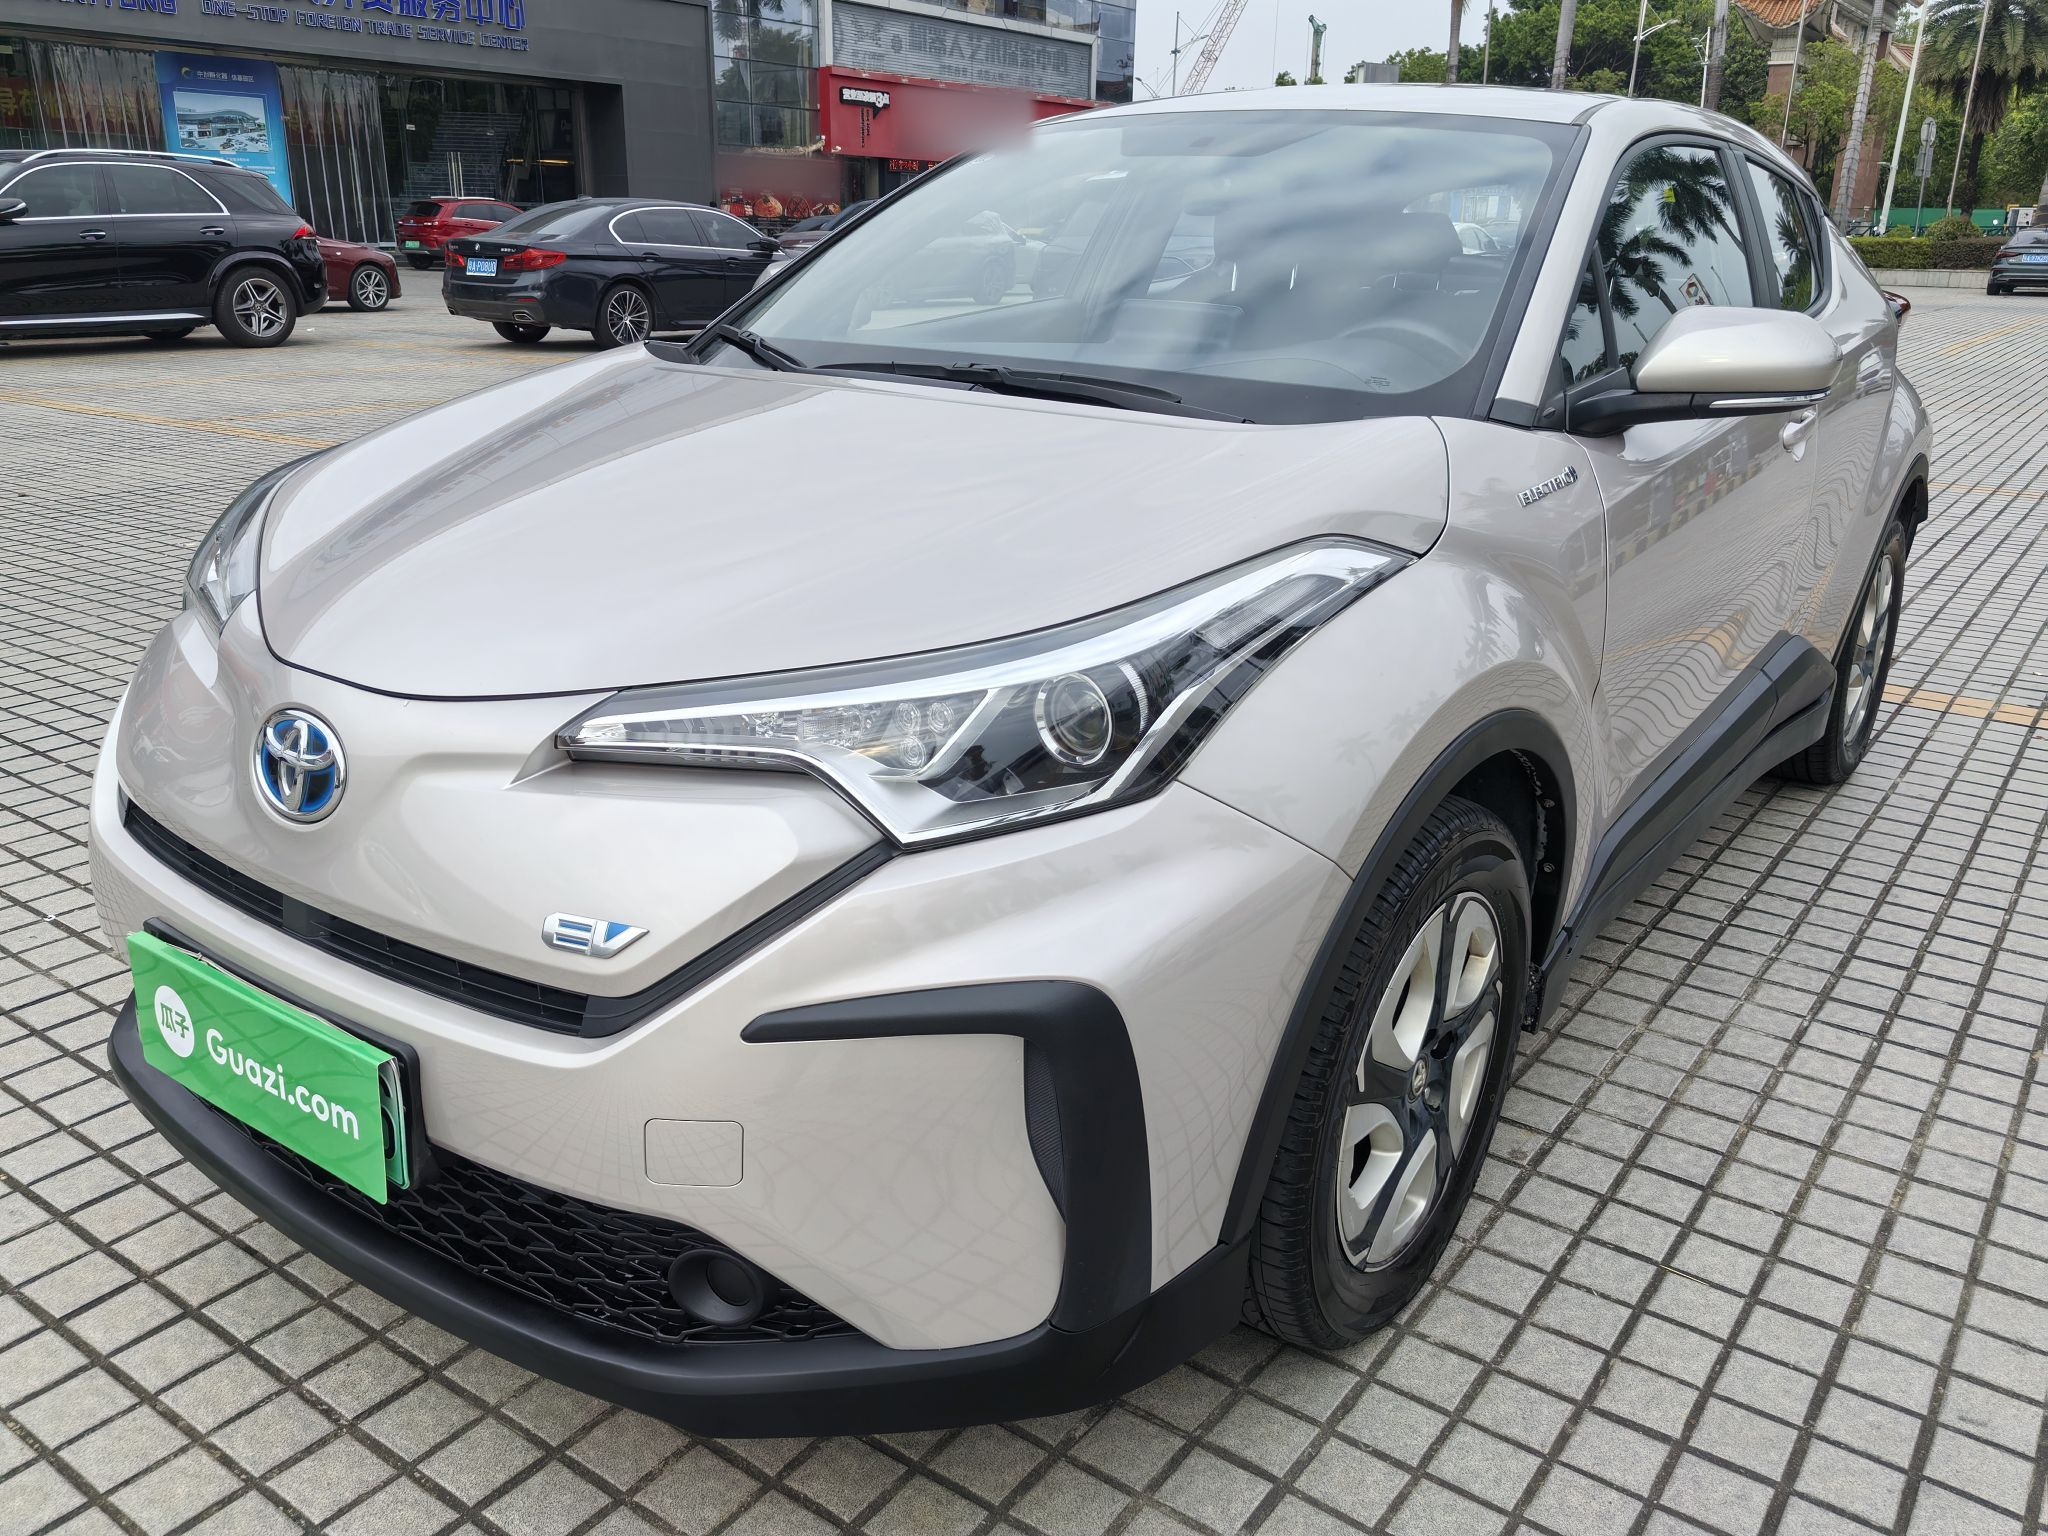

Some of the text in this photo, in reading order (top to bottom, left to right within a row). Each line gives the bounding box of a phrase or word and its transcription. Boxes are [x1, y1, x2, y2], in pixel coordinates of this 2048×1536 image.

[202, 0, 530, 51] ONE-STOP FOREIGN TRADE SERVICE CENTER
[1518, 470, 1574, 506] ELECTRIC
[541, 912, 650, 959] EV
[159, 1001, 190, 1039] 瓜子
[206, 1028, 360, 1140] Guazi.com
